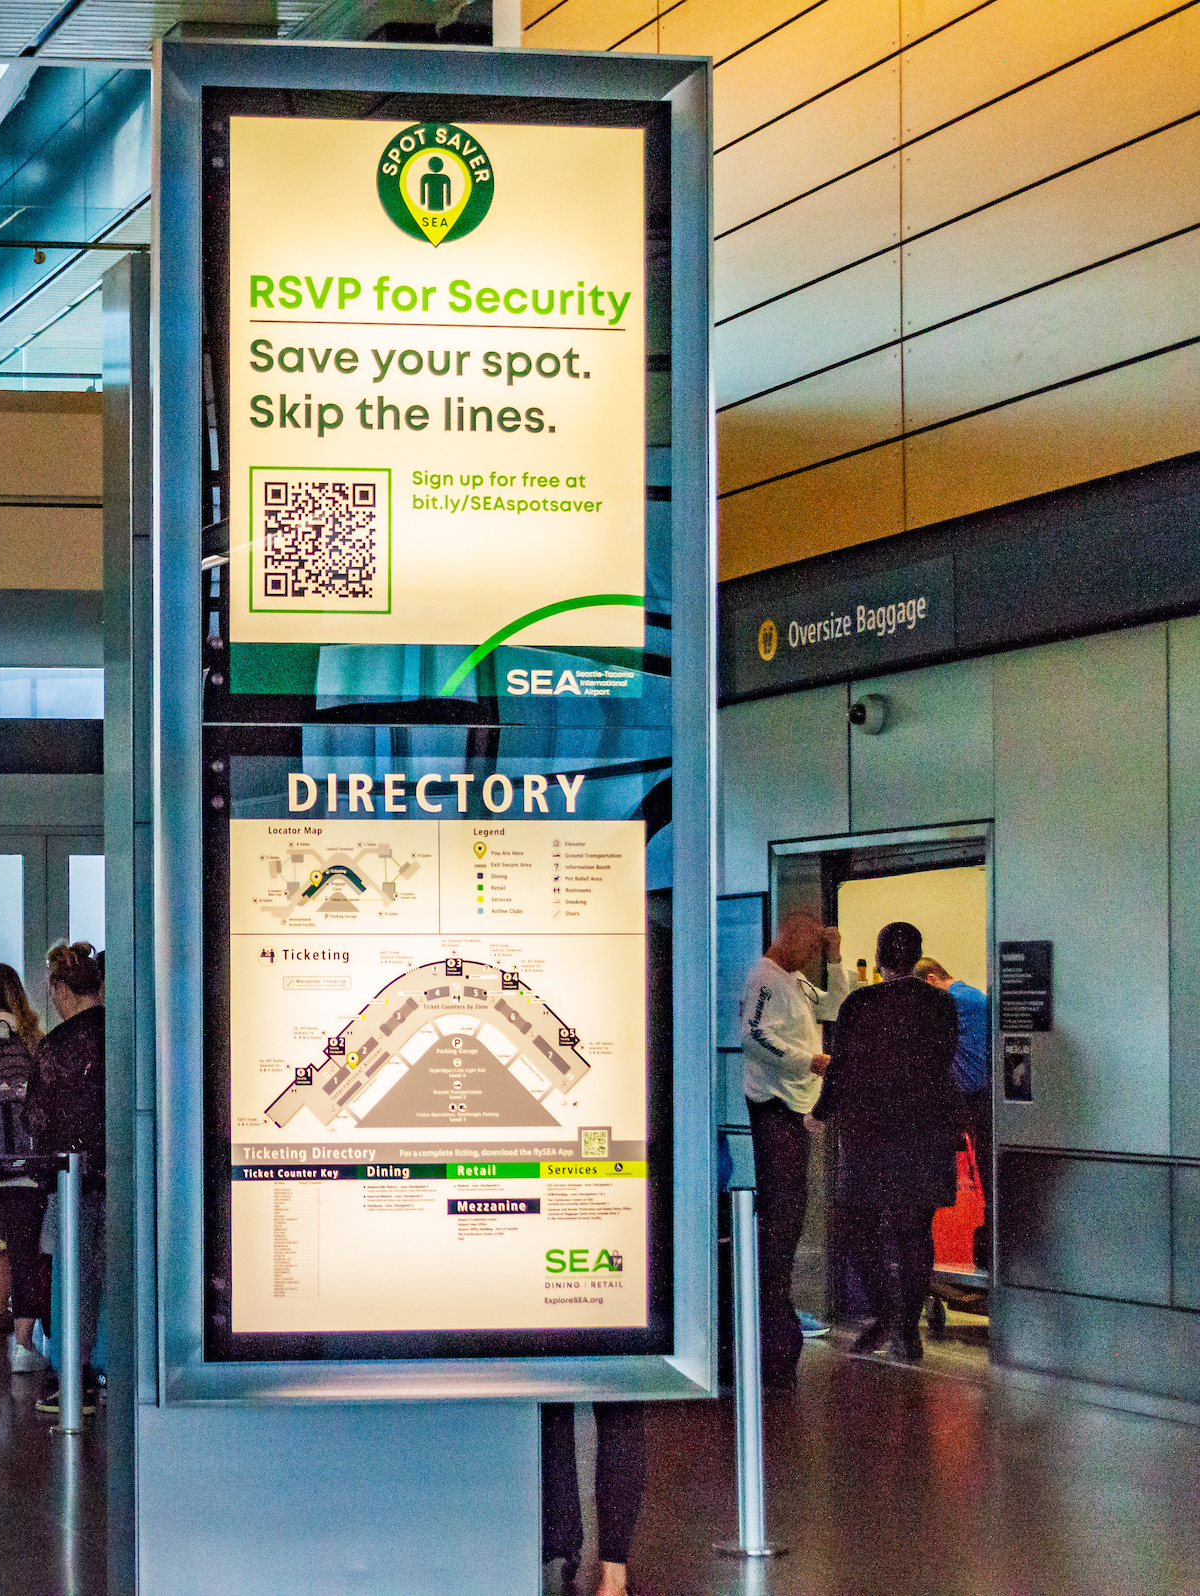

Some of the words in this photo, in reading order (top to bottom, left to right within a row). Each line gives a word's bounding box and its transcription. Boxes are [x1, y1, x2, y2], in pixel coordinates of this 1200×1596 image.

[382, 128, 426, 176] SPOT
[435, 128, 490, 183] SAVER
[422, 217, 448, 228] SEA
[249, 275, 361, 310] RSVP
[373, 276, 437, 312] for
[448, 279, 632, 325] Security
[249, 339, 359, 374] Save
[372, 348, 471, 383] your
[482, 347, 591, 386] spot.
[249, 394, 344, 437] Skip
[356, 396, 430, 431] the
[444, 397, 556, 433] lines.
[412, 470, 454, 491] Sign
[460, 474, 484, 490] up
[489, 471, 517, 488] for
[521, 472, 560, 489] free
[565, 474, 586, 489] at
[412, 494, 603, 514] bit.ly/SEAspotsaver
[788, 611, 851, 648] Oversize
[856, 597, 926, 636] Baggage
[575, 670, 634, 678] Seattle-Tacoma
[506, 669, 581, 695] SEA
[584, 688, 610, 696] Airport
[287, 772, 585, 813] DIRECTORY
[268, 827, 301, 835] Locator
[304, 827, 323, 837] Map
[473, 828, 505, 837] Legend
[282, 949, 350, 963] Ticketing
[456, 959, 462, 968] 3
[513, 972, 518, 981] 4
[434, 988, 440, 997] 4
[473, 989, 479, 997] 5
[396, 1012, 401, 1020] 3
[510, 1013, 516, 1021] 6
[569, 1029, 575, 1038] 5
[338, 1038, 344, 1047] 2
[361, 1046, 367, 1055] 2
[547, 1051, 553, 1059] 7
[306, 1068, 311, 1077] 1
[331, 1067, 363, 1100] International
[333, 1076, 338, 1085] 1
[243, 1147, 307, 1162] Ticketing
[312, 1147, 376, 1162] Directory
[399, 1149, 412, 1157] For
[418, 1149, 453, 1158] complete
[455, 1149, 480, 1158] listing,
[481, 1148, 518, 1156] download
[519, 1148, 532, 1156] the
[533, 1147, 556, 1157] flySEA
[558, 1148, 574, 1157] App
[243, 1168, 274, 1178] Ticket
[277, 1168, 317, 1178] Counter
[320, 1168, 339, 1179] Key
[366, 1165, 411, 1179] Dining
[457, 1164, 496, 1176] Retail
[547, 1164, 598, 1175] Services
[457, 1200, 527, 1212] Mezzanine
[545, 1248, 617, 1273] SEA
[544, 1281, 580, 1289] DINING
[544, 1296, 604, 1304] ExploreSEA.org
